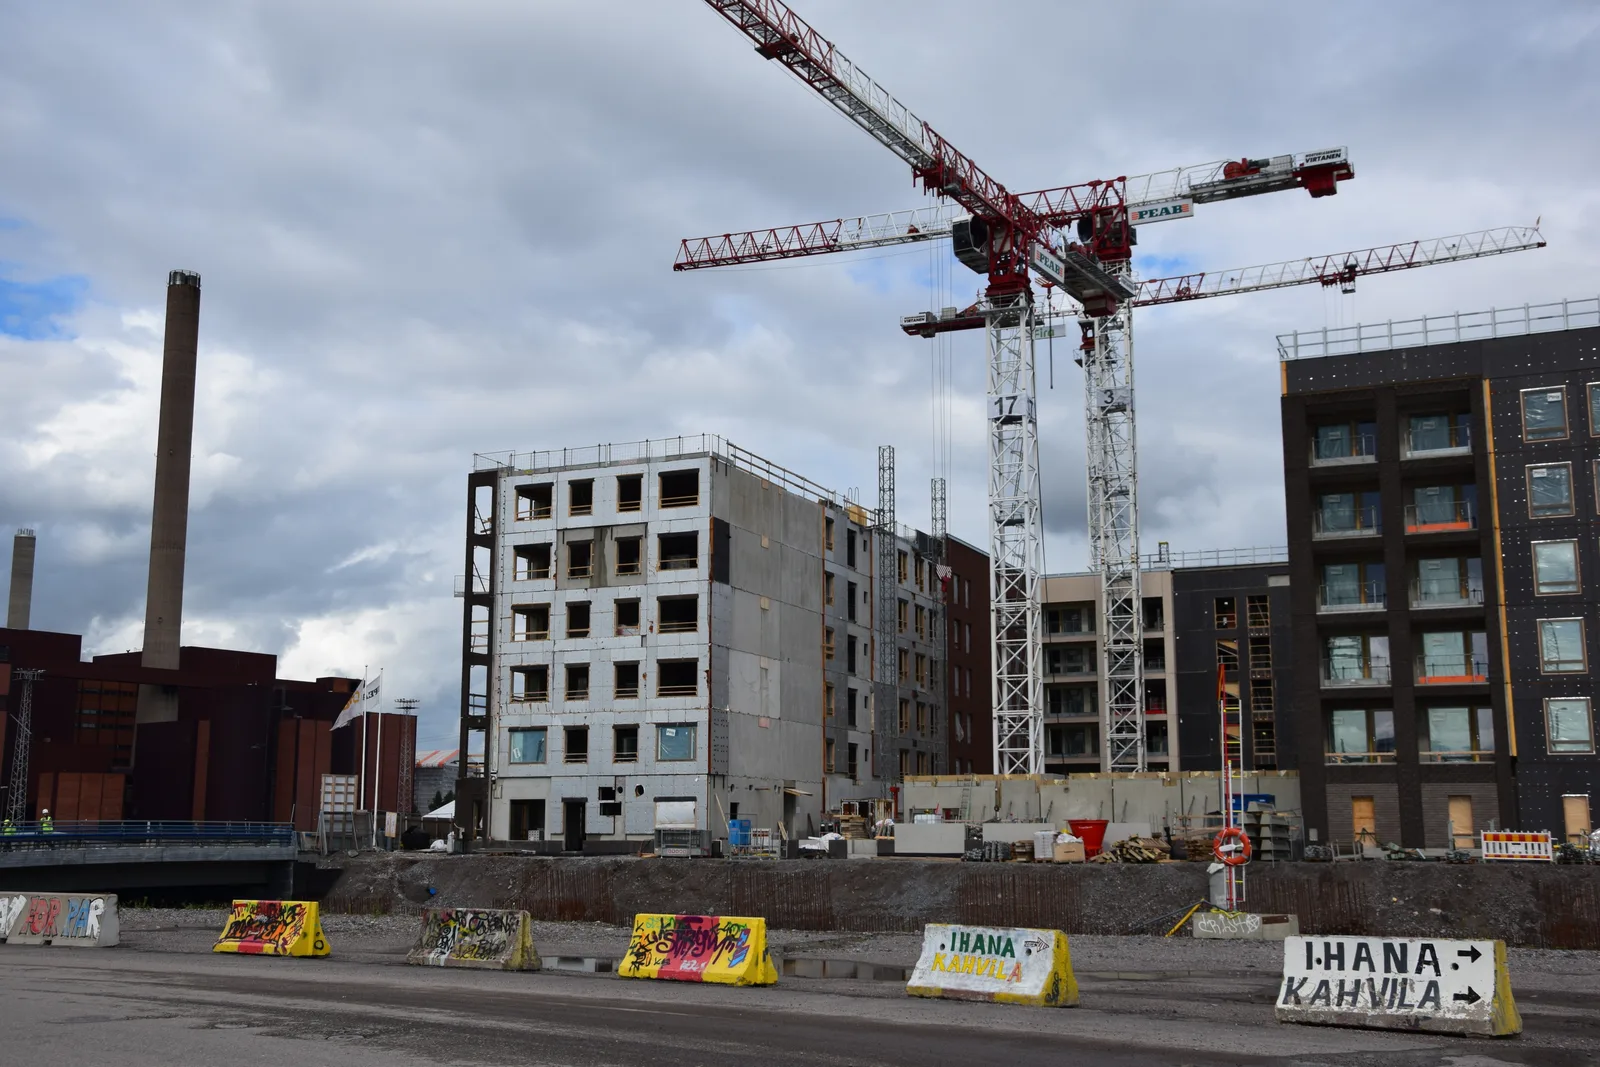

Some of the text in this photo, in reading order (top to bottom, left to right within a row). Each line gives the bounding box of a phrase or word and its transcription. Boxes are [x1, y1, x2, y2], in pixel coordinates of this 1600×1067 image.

[1305, 153, 1342, 163] VIRTANEN
[1138, 204, 1183, 220] PEAB
[1039, 252, 1061, 274] PEAB
[994, 396, 1018, 415] 17
[1104, 390, 1114, 404] 3
[18, 896, 62, 938] FOR
[949, 931, 1016, 959] IHANA
[1305, 941, 1442, 977] IHANA
[1282, 976, 1441, 1010] KAHVILA
